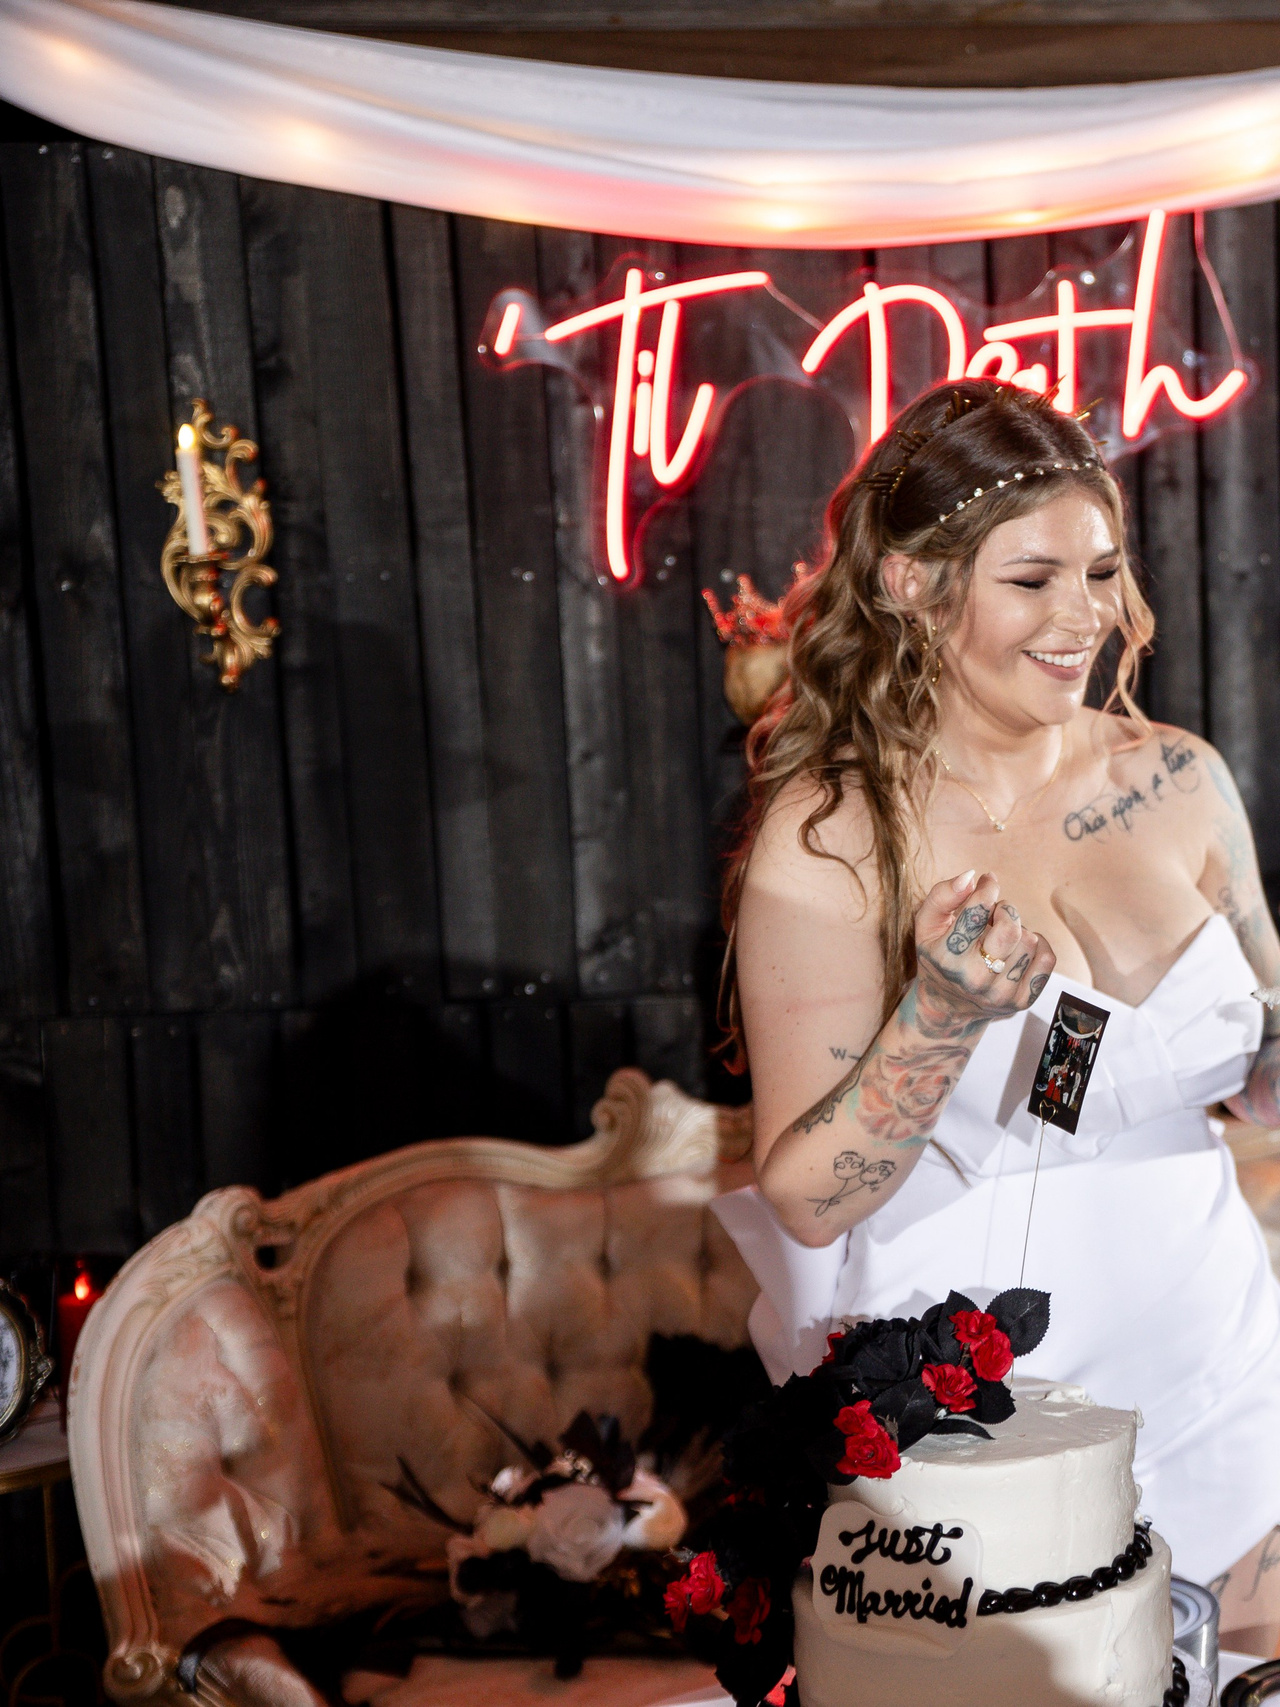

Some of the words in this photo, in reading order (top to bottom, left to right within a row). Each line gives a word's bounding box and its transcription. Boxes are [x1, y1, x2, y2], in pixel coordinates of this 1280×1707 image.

[1063, 805, 1108, 841] Once
[1111, 786, 1146, 832] upon
[820, 1564, 974, 1628] Married
